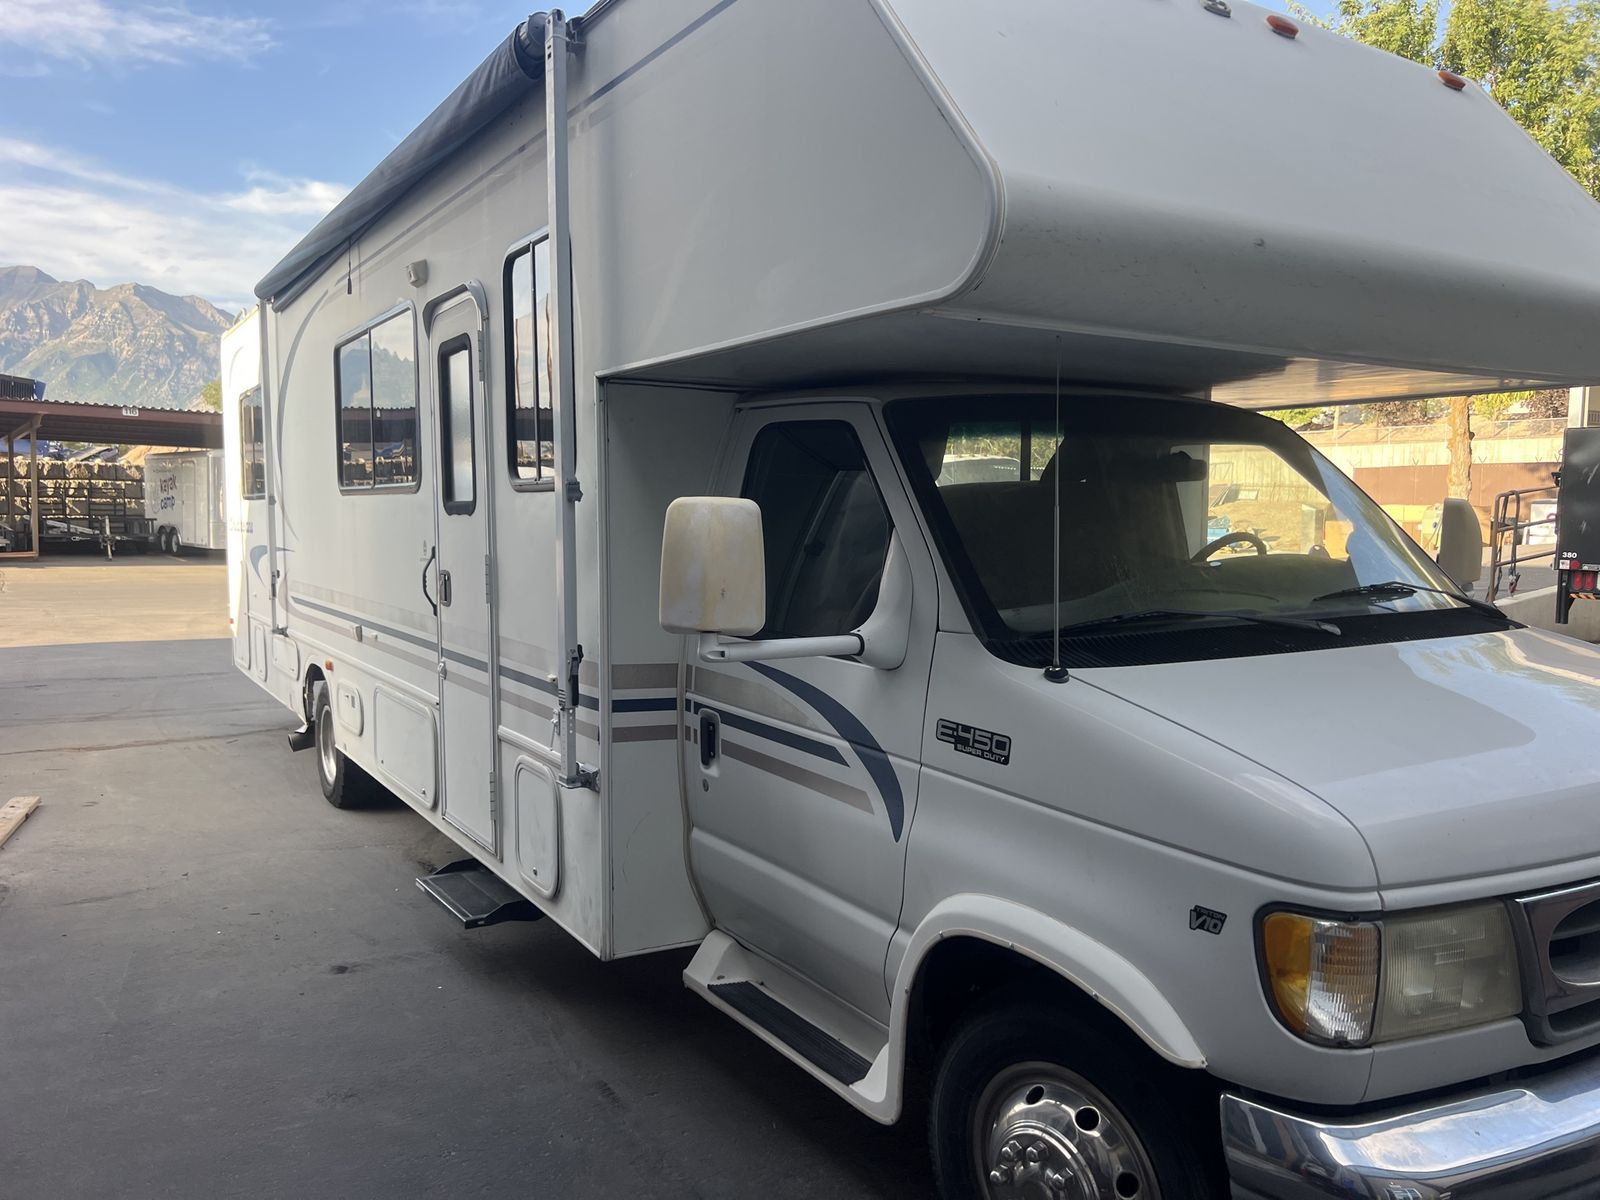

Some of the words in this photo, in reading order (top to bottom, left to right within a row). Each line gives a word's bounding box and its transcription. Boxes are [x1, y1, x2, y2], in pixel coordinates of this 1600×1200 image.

[161, 496, 175, 511] camp
[956, 743, 982, 757] SUPER
[983, 750, 1005, 763] DUTY
[1190, 910, 1223, 934] V10
